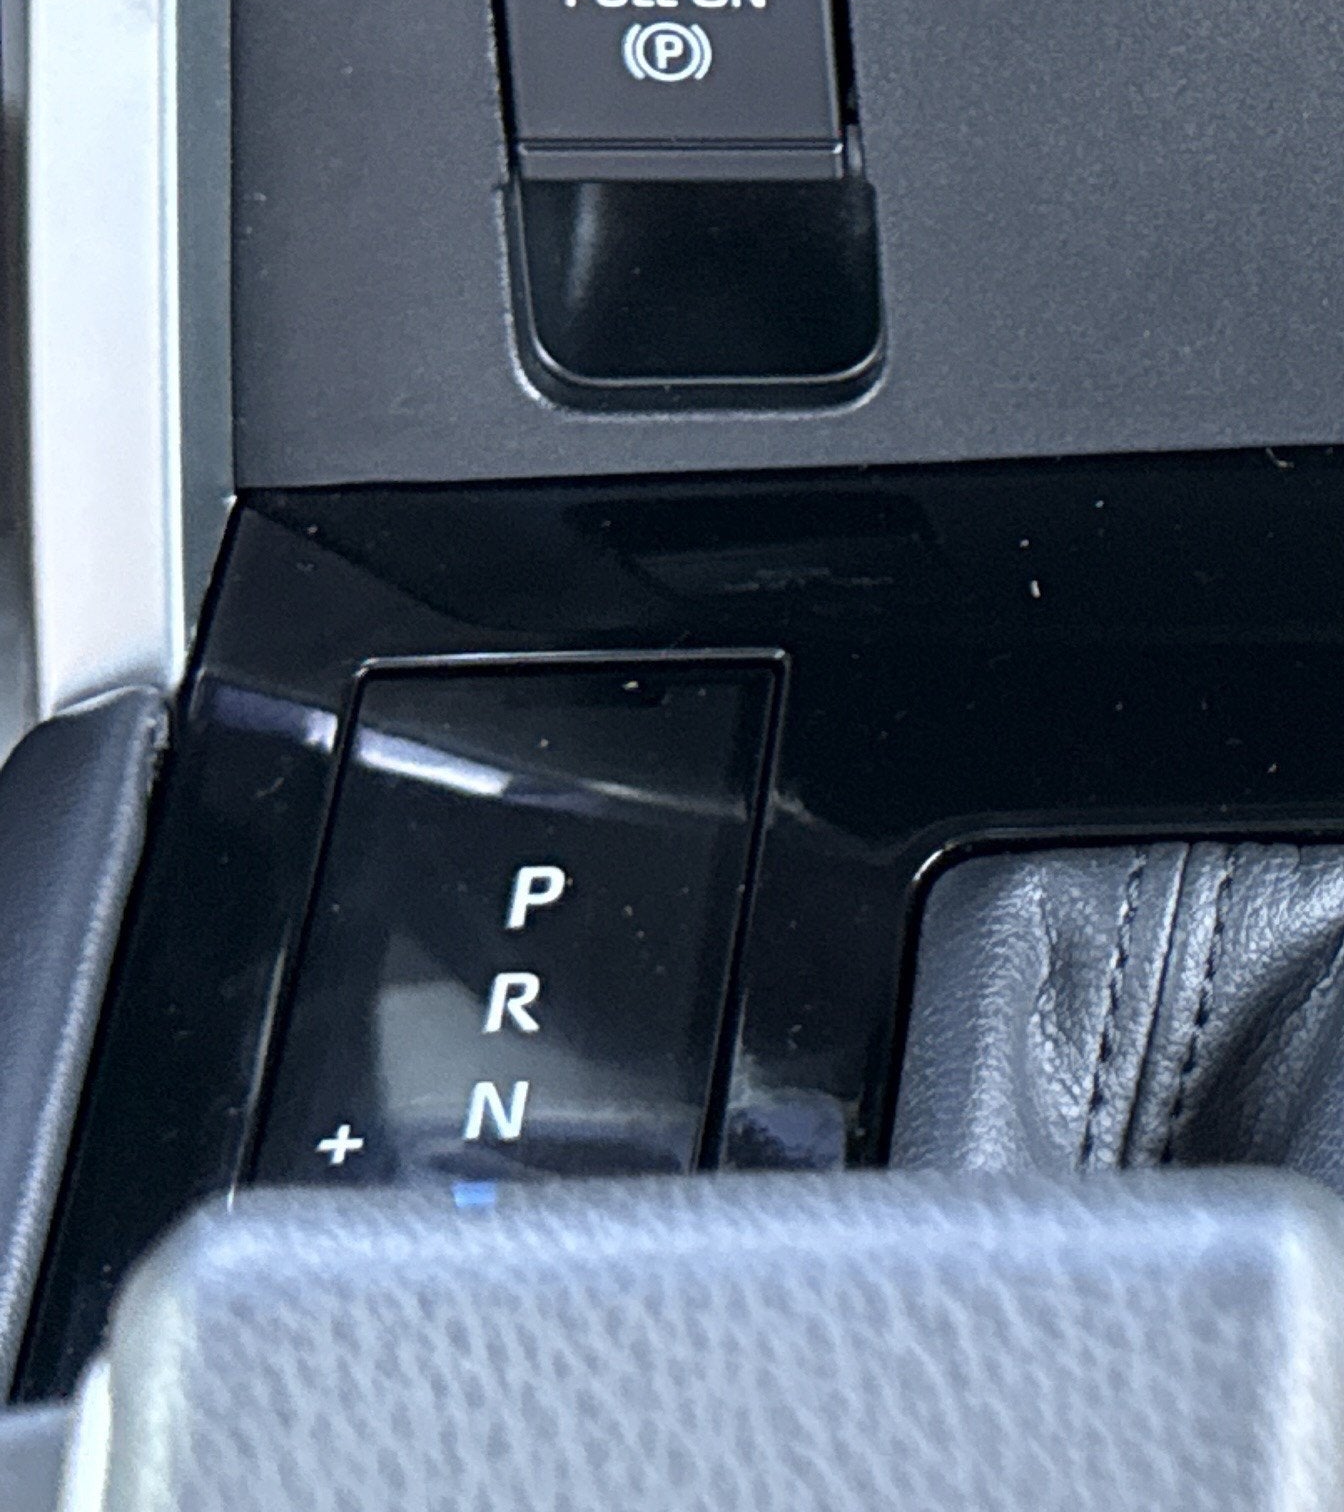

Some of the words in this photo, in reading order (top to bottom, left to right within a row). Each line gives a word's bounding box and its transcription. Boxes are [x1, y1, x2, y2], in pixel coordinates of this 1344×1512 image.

[505, 864, 566, 930] P
[481, 971, 541, 1035] R
[462, 1079, 530, 1141] N
